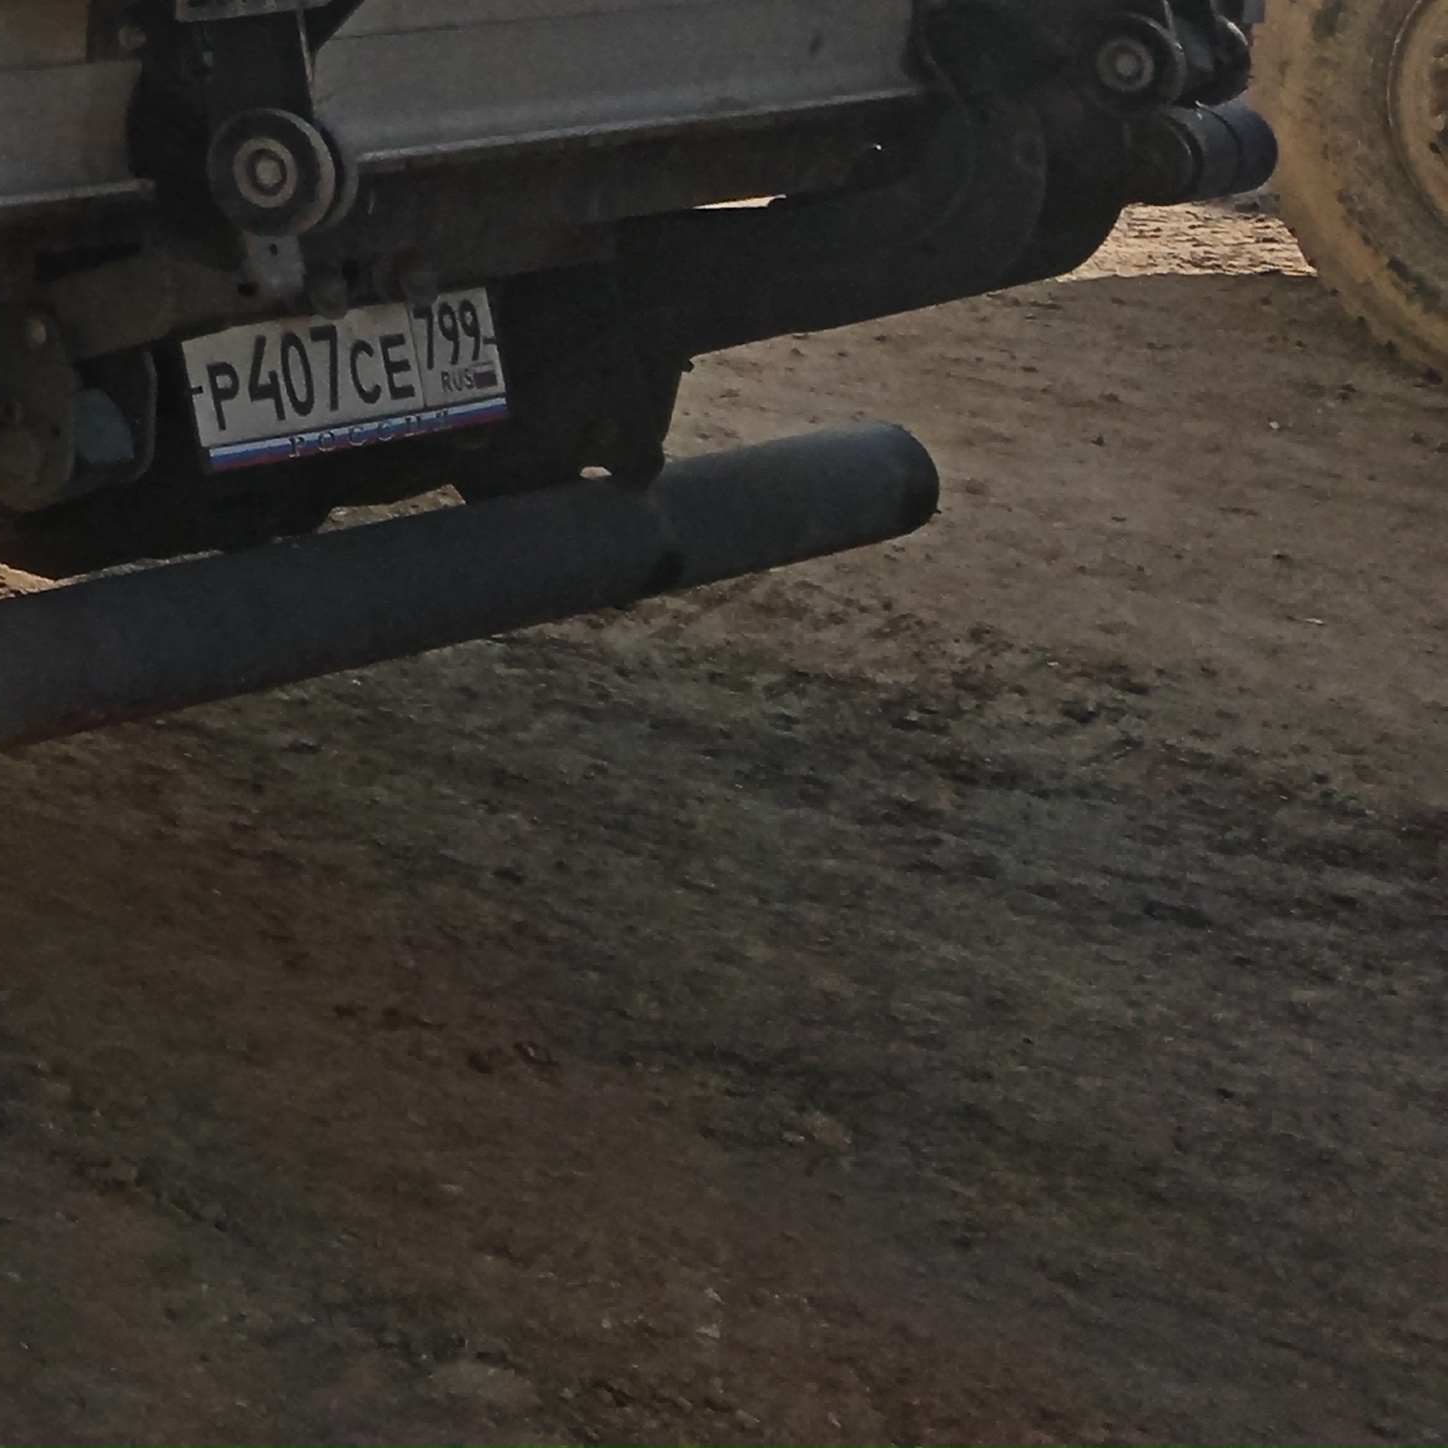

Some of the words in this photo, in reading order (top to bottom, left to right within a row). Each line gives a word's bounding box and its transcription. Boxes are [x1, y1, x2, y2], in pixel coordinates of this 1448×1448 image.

[206, 323, 416, 432] Р407СЕ
[412, 299, 483, 371] 799
[440, 370, 475, 394] RUS
